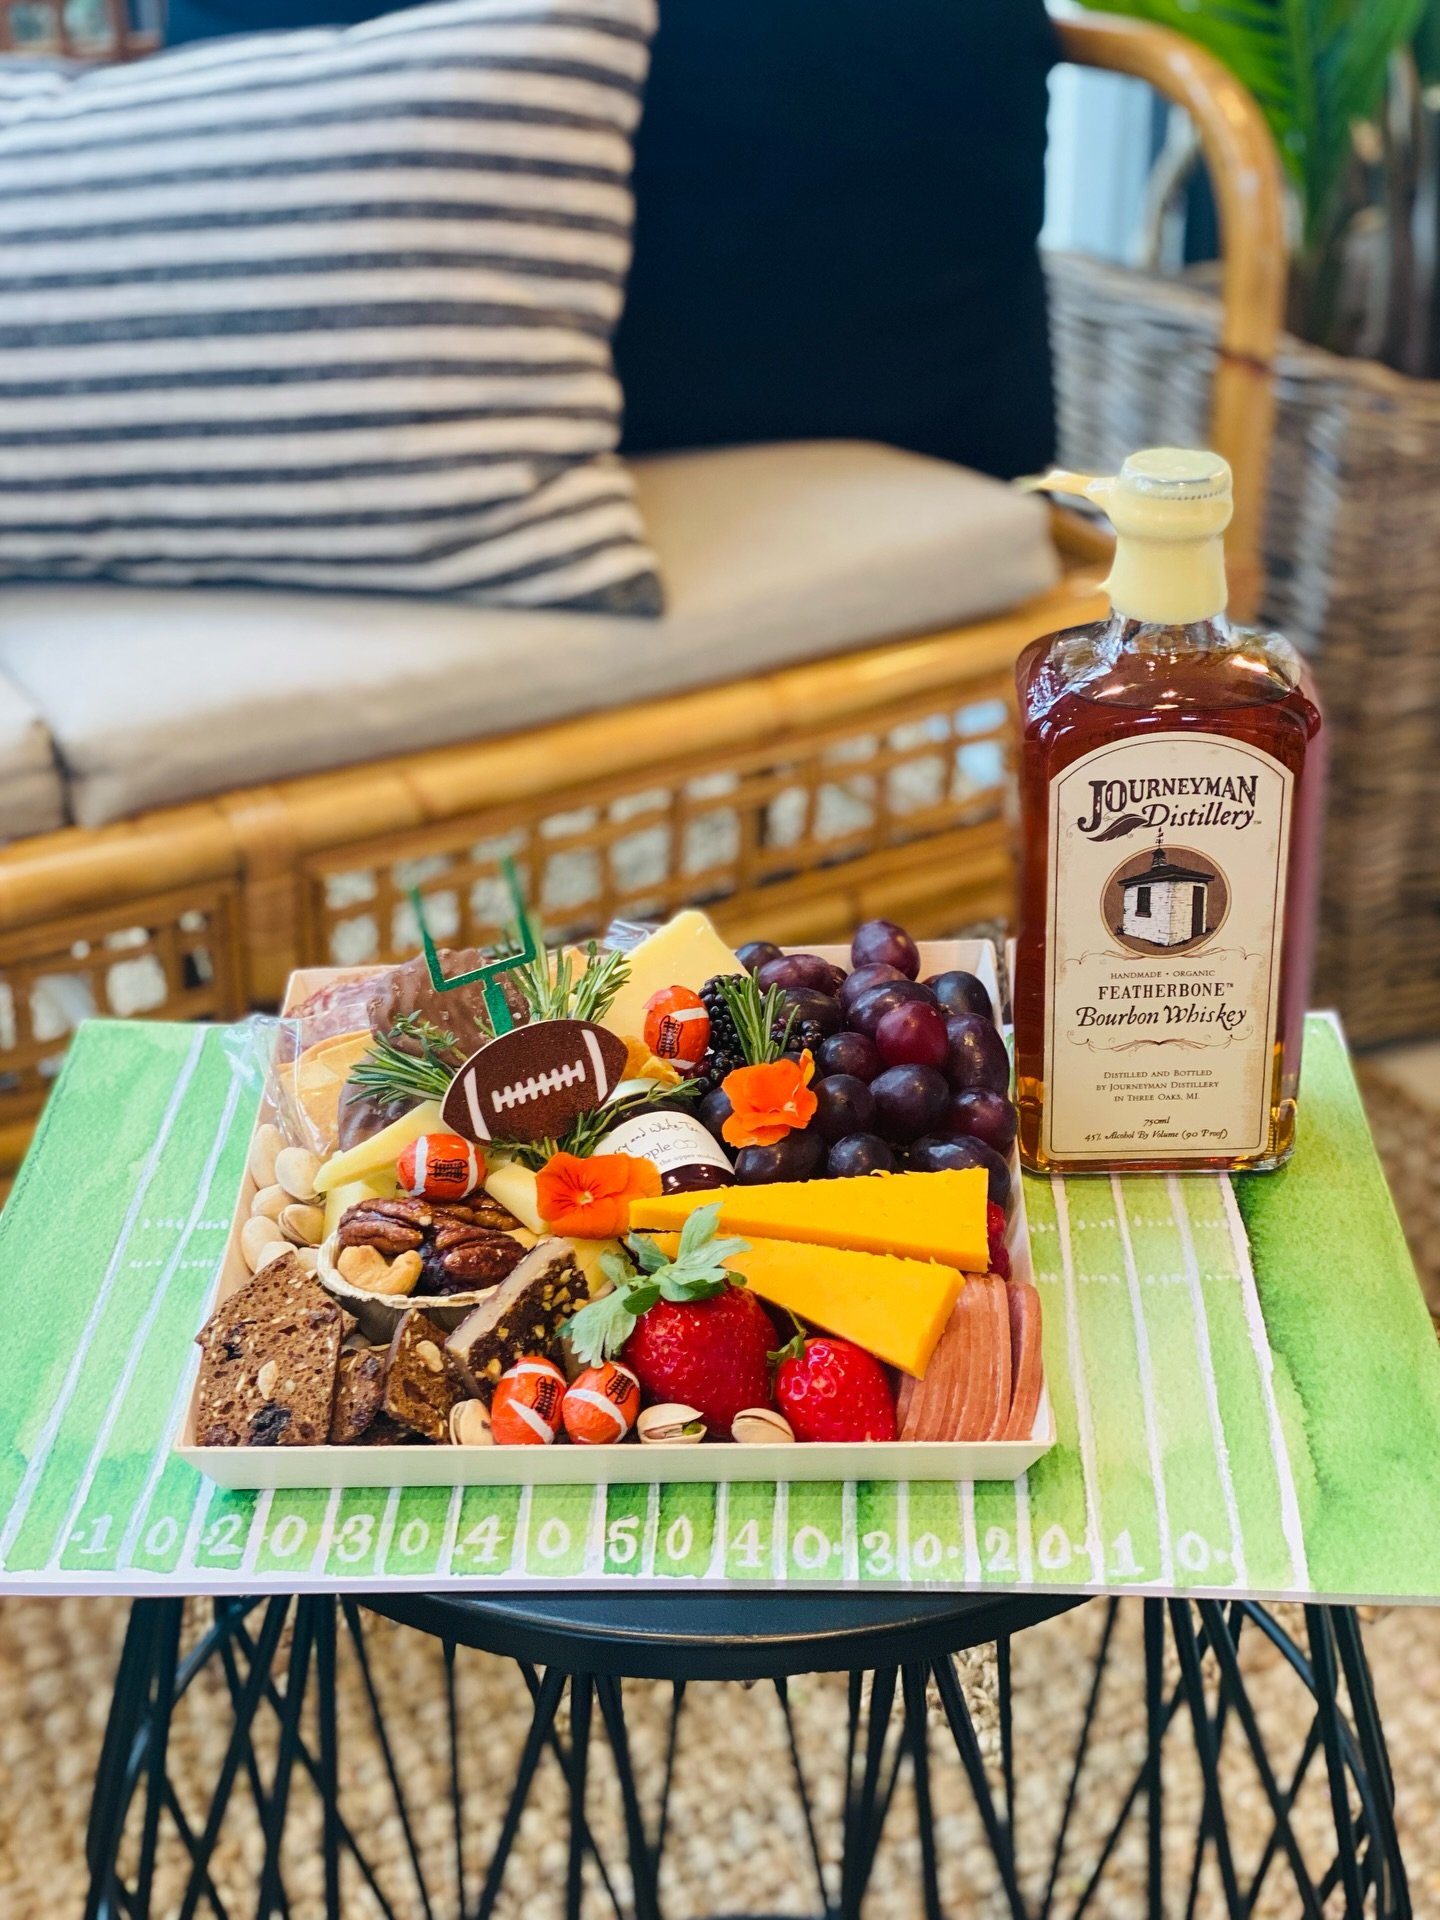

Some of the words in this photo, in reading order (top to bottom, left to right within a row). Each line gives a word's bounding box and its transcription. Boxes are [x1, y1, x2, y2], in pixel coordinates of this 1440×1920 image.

[1077, 775, 1259, 833] JOURNEYMAN
[1110, 971, 1162, 980] HANDMADE
[1172, 969, 1216, 978] ORGANIC
[1075, 1004, 1159, 1027] Bourbon
[1163, 1003, 1247, 1031] Whiskey
[1103, 1070, 1148, 1079] DISTILLED
[1151, 1070, 1170, 1078] AND
[1173, 1069, 1213, 1077] BOTTLED
[1109, 1082, 1167, 1092] JOURNEYMAN
[1171, 1081, 1220, 1089] DISTILLERY
[1127, 1094, 1155, 1102] THREE
[1143, 1116, 1171, 1127] 750ml
[1085, 1132, 1102, 1143] 45%
[1104, 1130, 1136, 1140] Alcohol
[1137, 1130, 1149, 1140] By
[1151, 1129, 1179, 1139] Volume
[1201, 1128, 1229, 1140] Proof)
